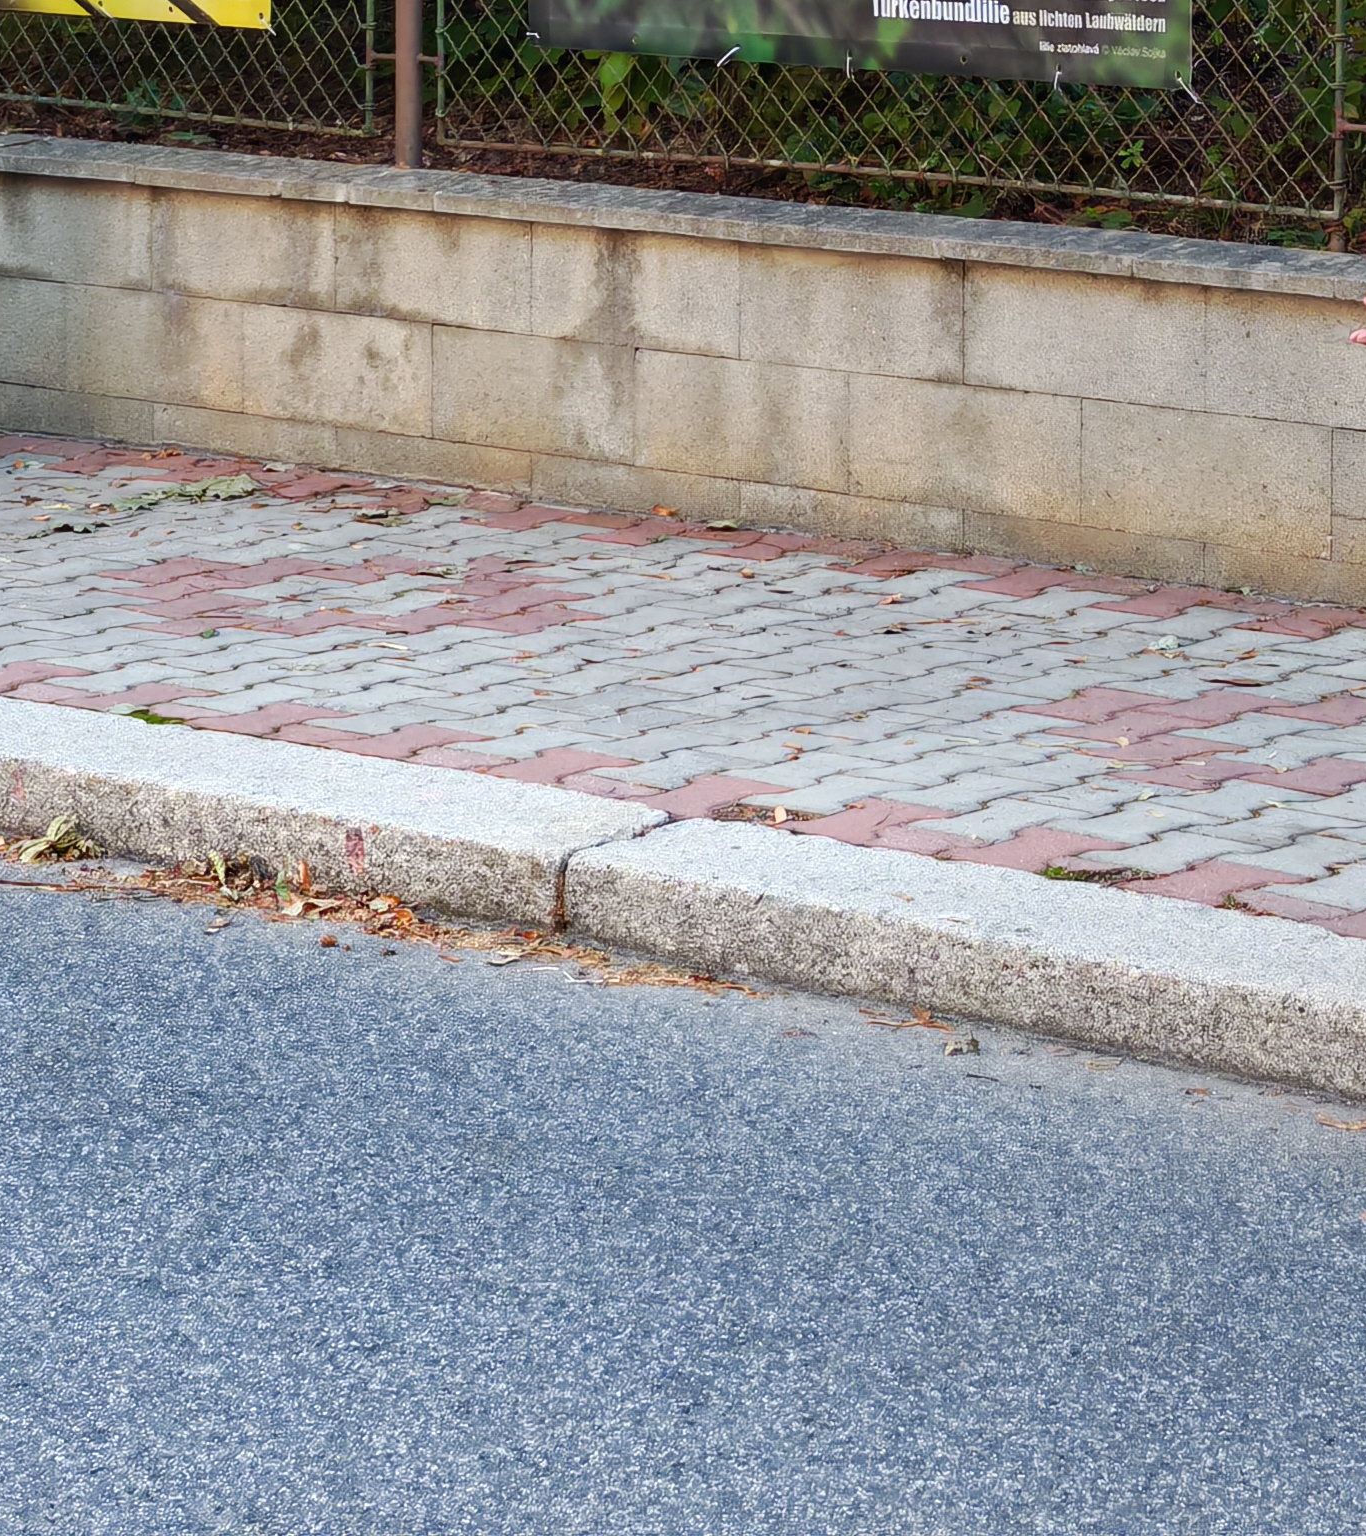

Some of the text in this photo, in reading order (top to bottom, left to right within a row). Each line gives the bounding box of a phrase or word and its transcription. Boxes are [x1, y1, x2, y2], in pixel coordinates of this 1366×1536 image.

[1012, 10, 1037, 26] aus
[1039, 9, 1083, 29] lichten
[1085, 12, 1166, 33] Laubwäldern
